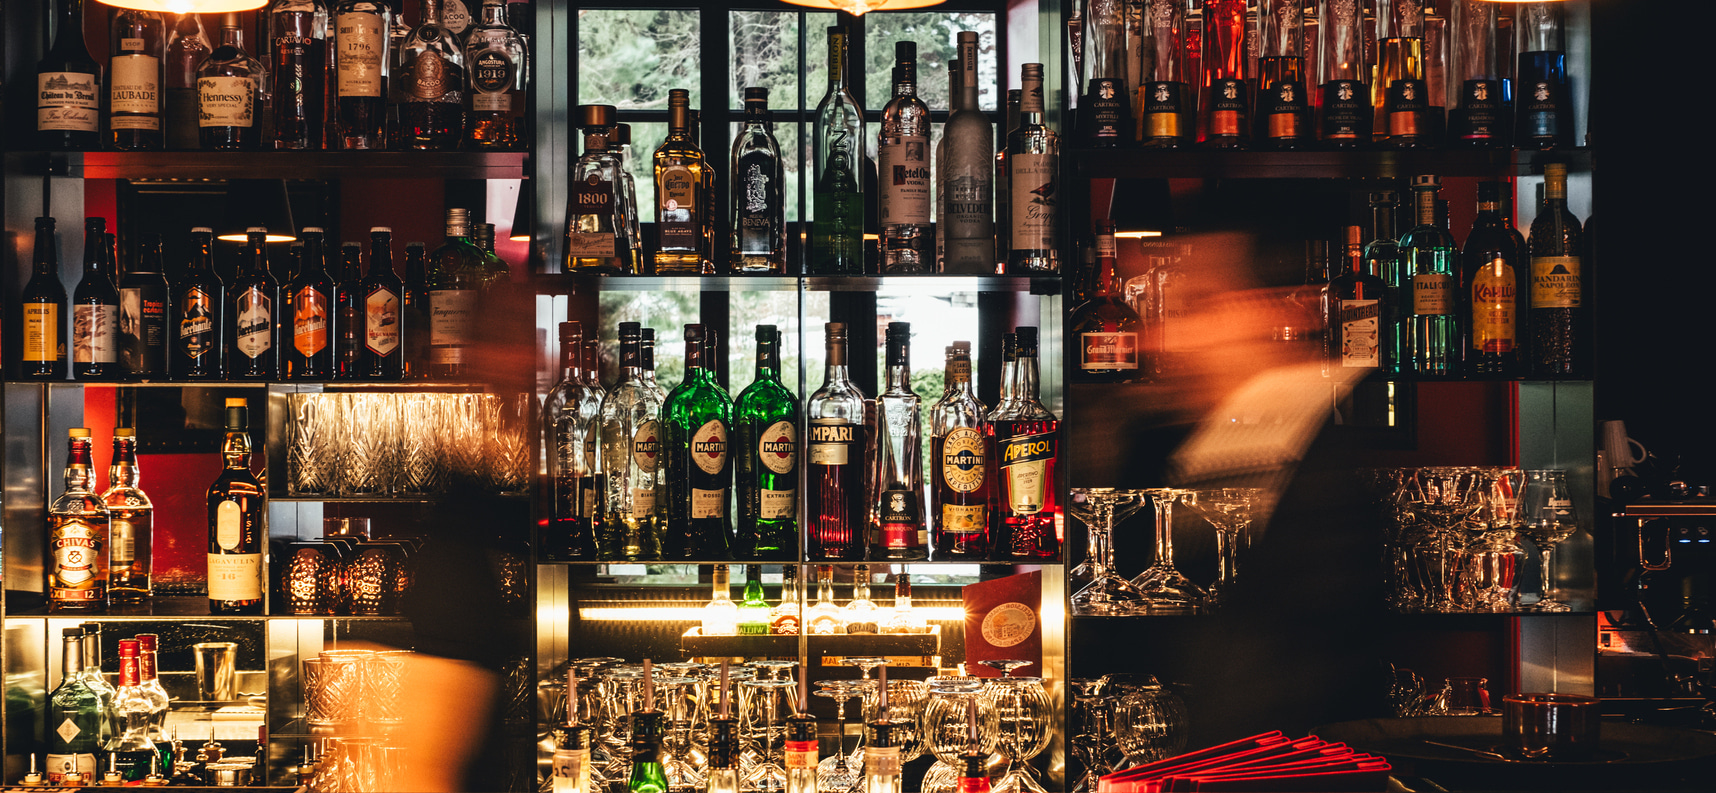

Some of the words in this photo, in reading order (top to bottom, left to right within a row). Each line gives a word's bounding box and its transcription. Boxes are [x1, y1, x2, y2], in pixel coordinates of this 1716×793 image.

[276, 36, 312, 47] CARTAVIO
[348, 43, 371, 51] 1796
[831, 37, 840, 77] LEBLON
[478, 70, 506, 79] 1919
[416, 79, 441, 87] BACOO
[113, 91, 156, 101] LAUBADE
[203, 93, 245, 105] Hennessy
[895, 165, 919, 184] Ketel
[578, 193, 608, 205] 1800
[742, 217, 770, 227] BENEVA
[946, 432, 960, 450] SANS
[953, 439, 978, 451] TORINO
[1004, 440, 1051, 462] APEROL
[945, 456, 984, 465] MARTINI
[56, 538, 96, 549] CHIVAS
[84, 589, 96, 599] 12
